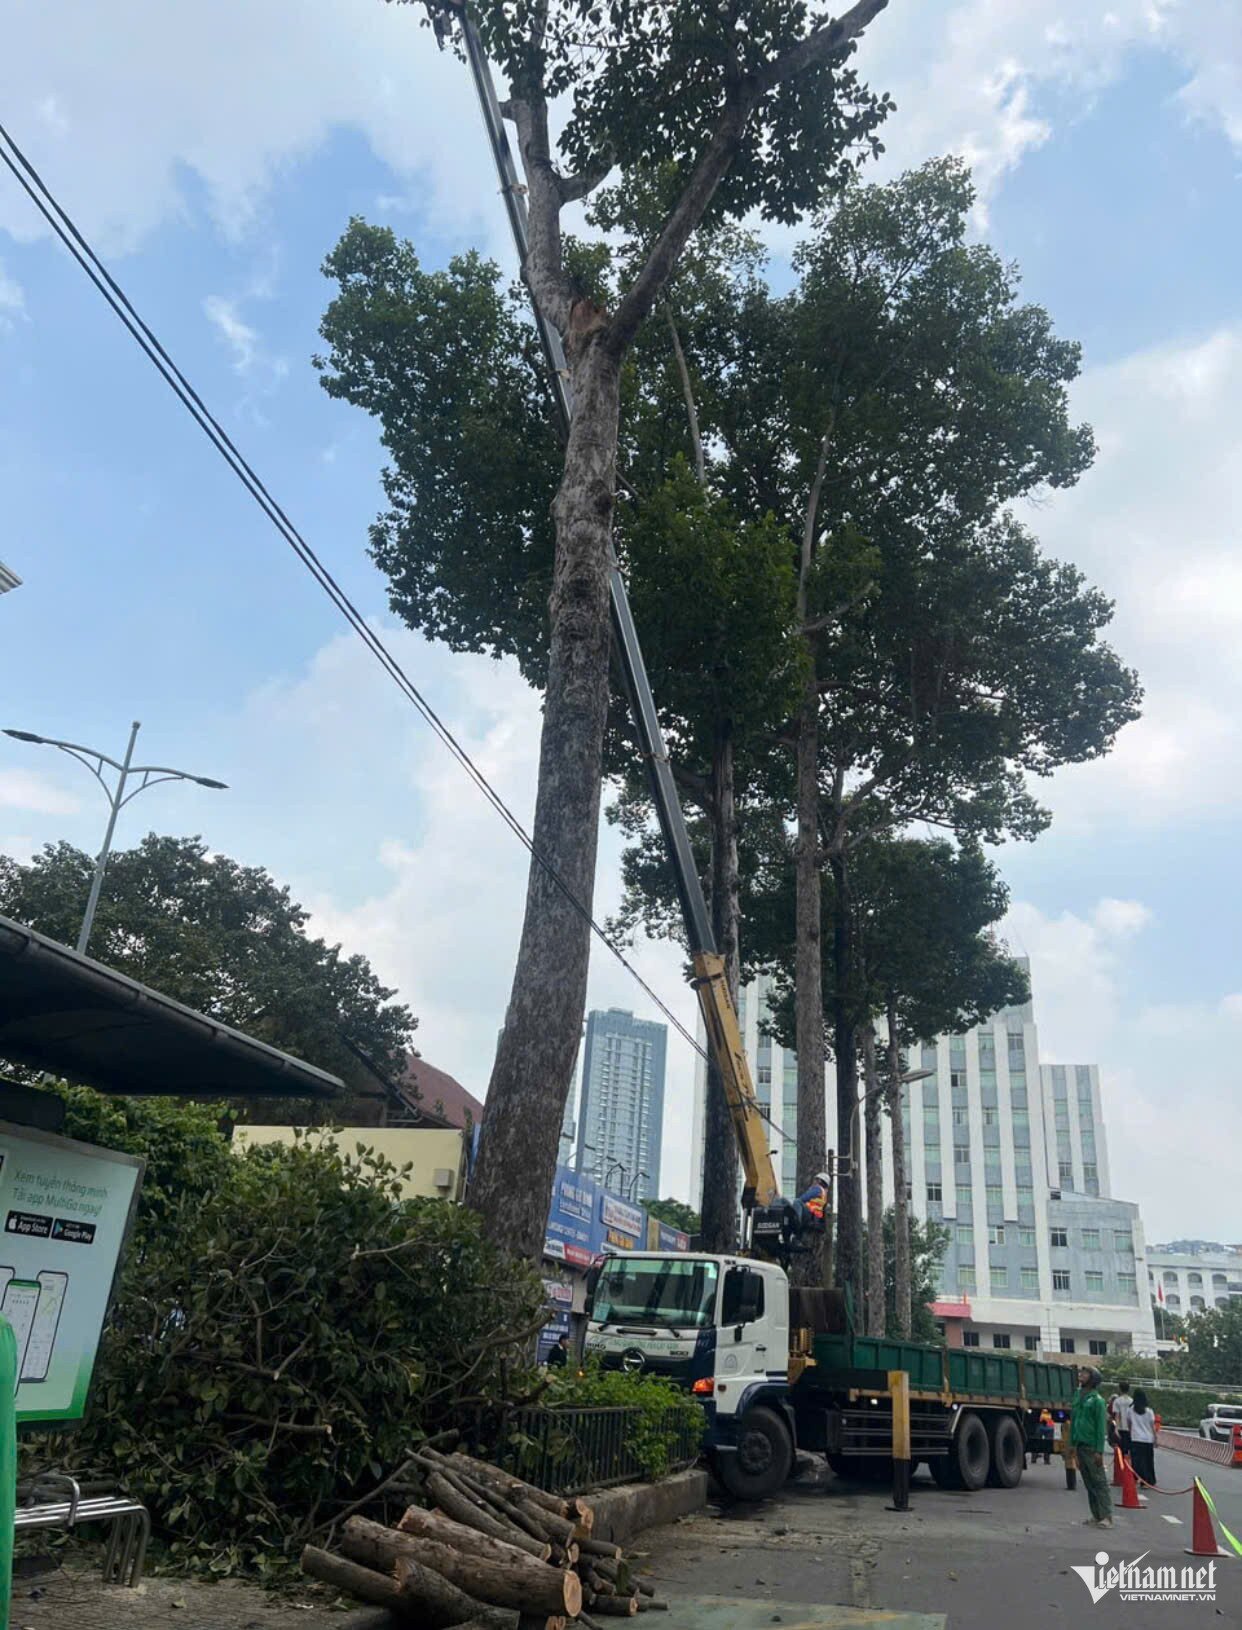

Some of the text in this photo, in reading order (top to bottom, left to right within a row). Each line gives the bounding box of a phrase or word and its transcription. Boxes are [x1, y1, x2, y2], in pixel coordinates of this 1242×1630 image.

[14, 1170, 35, 1184] Xem
[26, 1193, 45, 1207] app
[17, 1220, 48, 1234] App Store
[63, 1228, 93, 1241] Google Play
